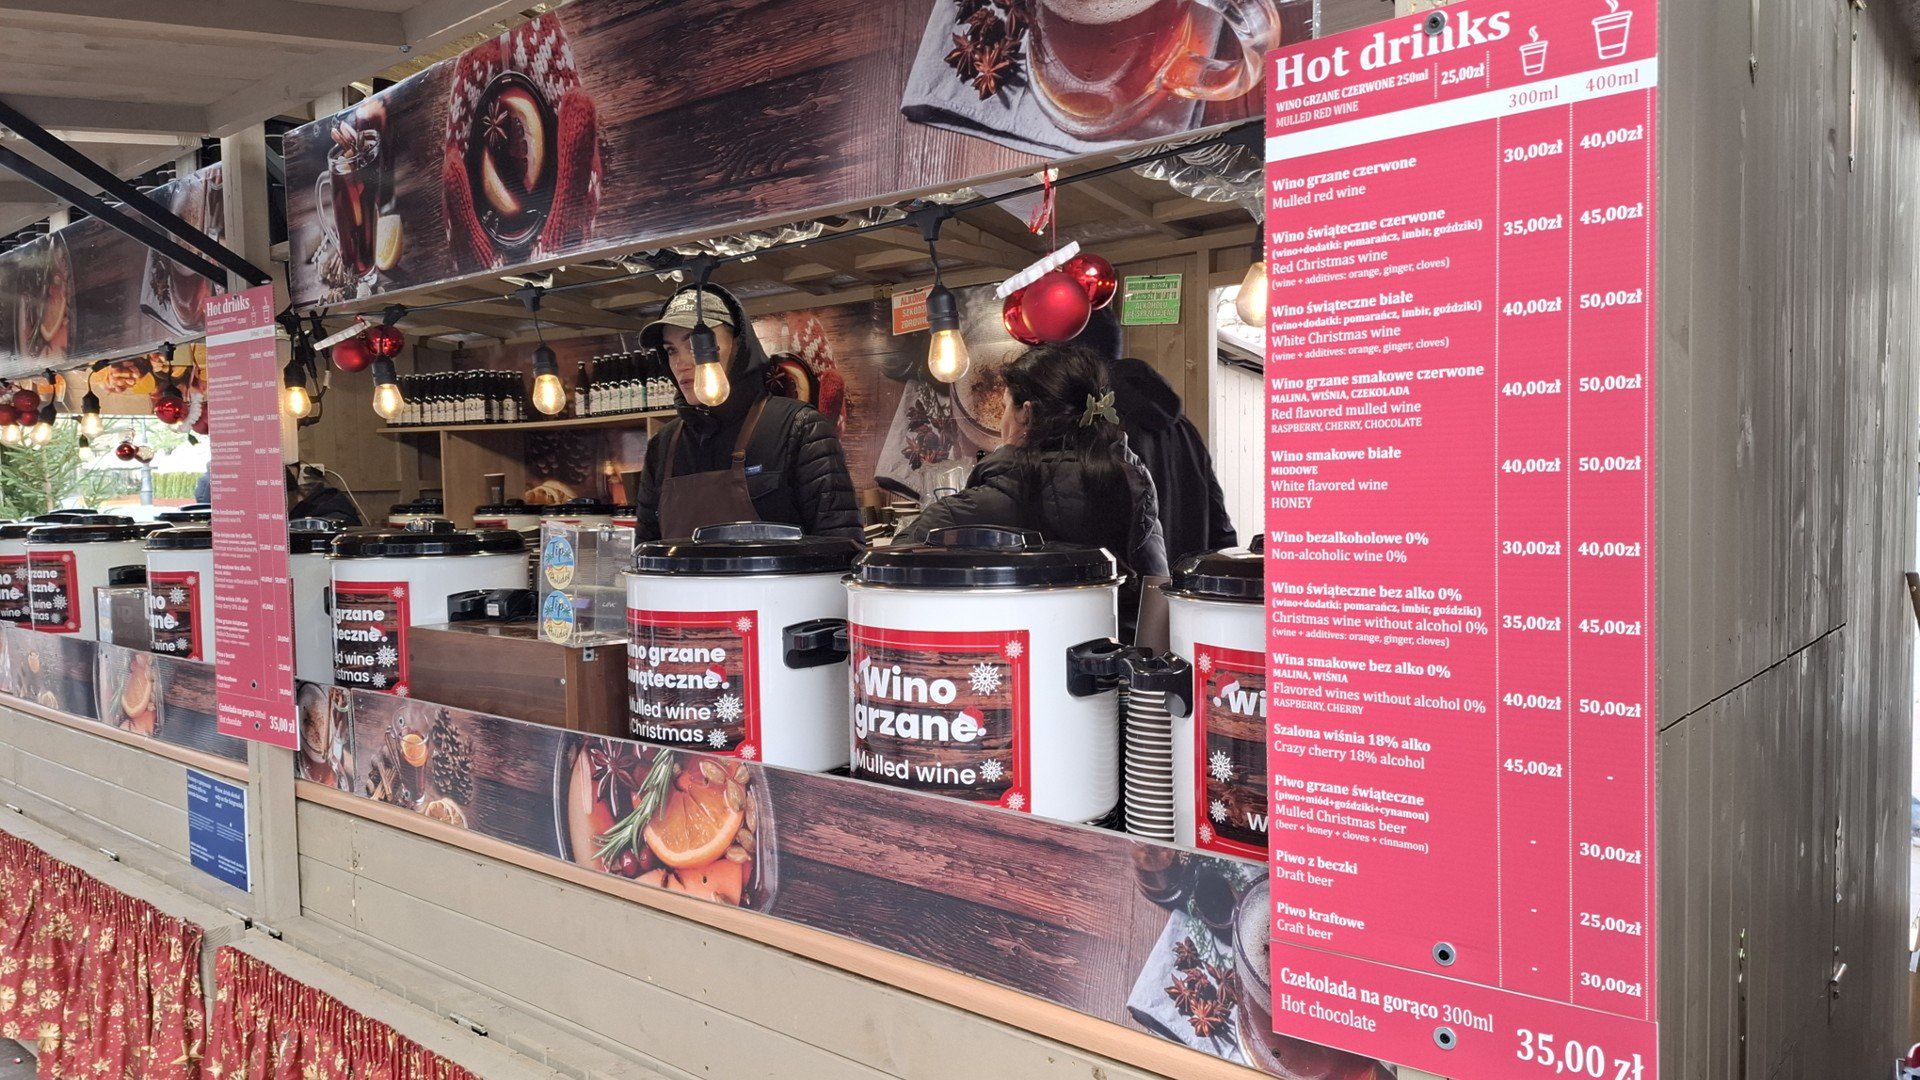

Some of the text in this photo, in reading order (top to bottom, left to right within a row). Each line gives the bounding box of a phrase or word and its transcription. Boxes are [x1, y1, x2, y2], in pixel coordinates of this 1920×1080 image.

[1275, 10, 1511, 92] Hot drinks
[1440, 62, 1485, 85] 25,00zł
[1586, 70, 1639, 92] 400ml
[1275, 68, 1429, 112] WINO GRZANE CZERWONE 250ml
[1509, 84, 1559, 108] 300ml
[1276, 100, 1358, 127] MULLED RED WINE
[1579, 124, 1643, 149] 40,00zł
[1503, 138, 1563, 163] 30,00zł
[1271, 157, 1417, 191] Wino grzane czerwone
[1272, 185, 1366, 209] Mulled red wine
[1503, 213, 1563, 236] 35,00zł
[1579, 202, 1643, 225] 45,00zł
[1271, 209, 1445, 244] Wino świąteczne czerwone
[1271, 218, 1483, 260] (wino+dodatki: pomarańcz, imbir, goździki)
[1272, 250, 1388, 274] Red Christmas wine
[206, 295, 250, 317] Hot drinks
[1271, 290, 1413, 317] Wino świąteczne białe
[1502, 296, 1562, 316] 40,00zł
[1579, 288, 1642, 309] 50,00zł
[1271, 325, 1401, 347] White Christmas wine
[1270, 365, 1484, 390] Wino grzane smakowe czerwone
[1501, 378, 1561, 397] 40,00zł
[1579, 373, 1642, 393] 50,00zł
[1271, 385, 1410, 403] MALINA, WIŚNIA, CZEKOLADA
[1271, 416, 1422, 433] RASPBERRY, CHERRY, CHOCOLATE
[1270, 445, 1402, 462] Wino smakowe białe
[1578, 455, 1642, 473] 50,00zł
[1271, 465, 1318, 475] MIODOWE
[1501, 457, 1561, 475] 40,00zł
[1270, 478, 1388, 491] White flavored wine
[1271, 496, 1313, 509] HONEY
[1270, 530, 1429, 545] Wino bezalkoholowe 0%
[1502, 540, 1561, 556] 30,00zł
[1271, 548, 1407, 563] Non-alcoholic wine 0%
[1577, 541, 1641, 558] 40,00zł
[1271, 581, 1462, 601] Wino świąteczne bez alko 0%
[1, 608, 21, 617] wine
[34, 600, 52, 609] wine
[335, 609, 385, 624] grzane
[1502, 614, 1561, 631] 35,00zł
[1577, 618, 1641, 635] 45,00zł
[345, 652, 374, 665] wine
[627, 643, 726, 666] ino grzane
[628, 665, 718, 690] wiąteczne
[863, 665, 956, 704] Wino
[665, 703, 711, 720] wine
[1228, 689, 1267, 717] Wi
[1502, 692, 1562, 710] 40,00zł
[1579, 698, 1642, 718] 50,00zł
[269, 715, 288, 733] 35,00
[630, 718, 704, 741] Christmas
[855, 703, 978, 743] grzane
[1273, 722, 1431, 752] Szalona wiśnia 18% alko
[1273, 739, 1425, 769] Crazy cherry 18% alcohol
[856, 748, 976, 785] Mulled wine
[1503, 757, 1562, 777] 45,00zł
[1274, 773, 1425, 806] Piwo grzane świąteczne
[1274, 789, 1429, 823] (piwo+miód+goździki+cynamon)
[1275, 803, 1407, 834] Mulled Christmas beer
[1275, 849, 1358, 875] Piwo z beczki
[1579, 841, 1642, 864] 30,00zł
[1276, 866, 1334, 887] Draft beer
[1276, 901, 1365, 930] Piwo kraftowe
[1579, 911, 1642, 936] 25,00zł
[1276, 918, 1333, 940] Craft beer
[1580, 971, 1642, 997] 30,00zł
[1280, 966, 1494, 1033] Czekolada na gorąco 300ml
[1281, 993, 1376, 1032] Hot chocolate
[1516, 1028, 1644, 1079] 35,00 zł
